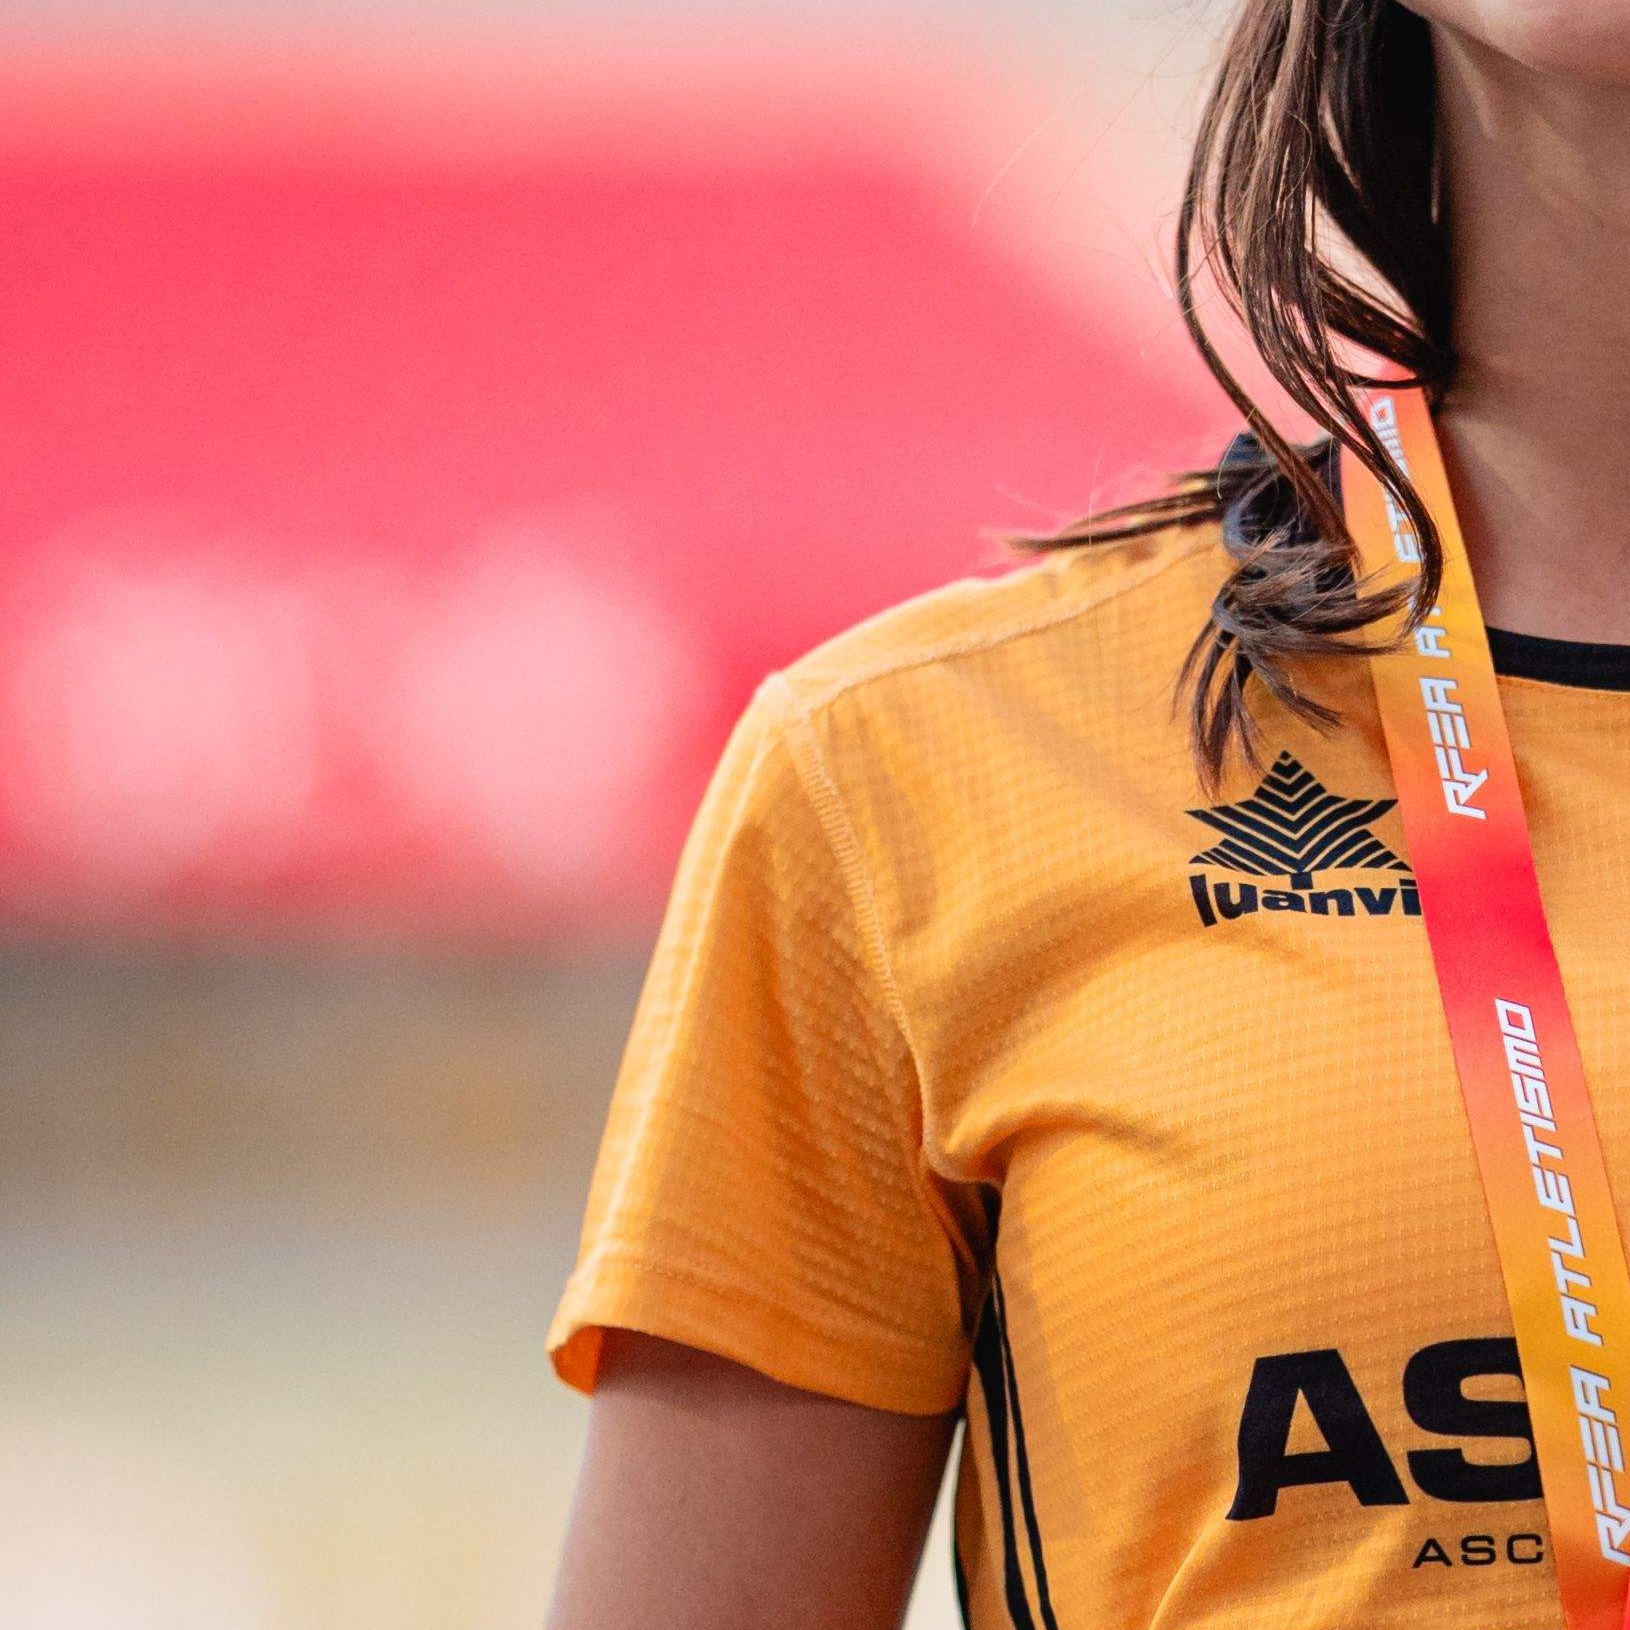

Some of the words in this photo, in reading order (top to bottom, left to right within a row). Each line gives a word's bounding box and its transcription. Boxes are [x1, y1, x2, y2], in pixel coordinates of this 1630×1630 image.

[1419, 677, 1489, 820] RFEA
[1189, 873, 1423, 928] luanvi
[1494, 997, 1605, 1346] ATLETISMO
